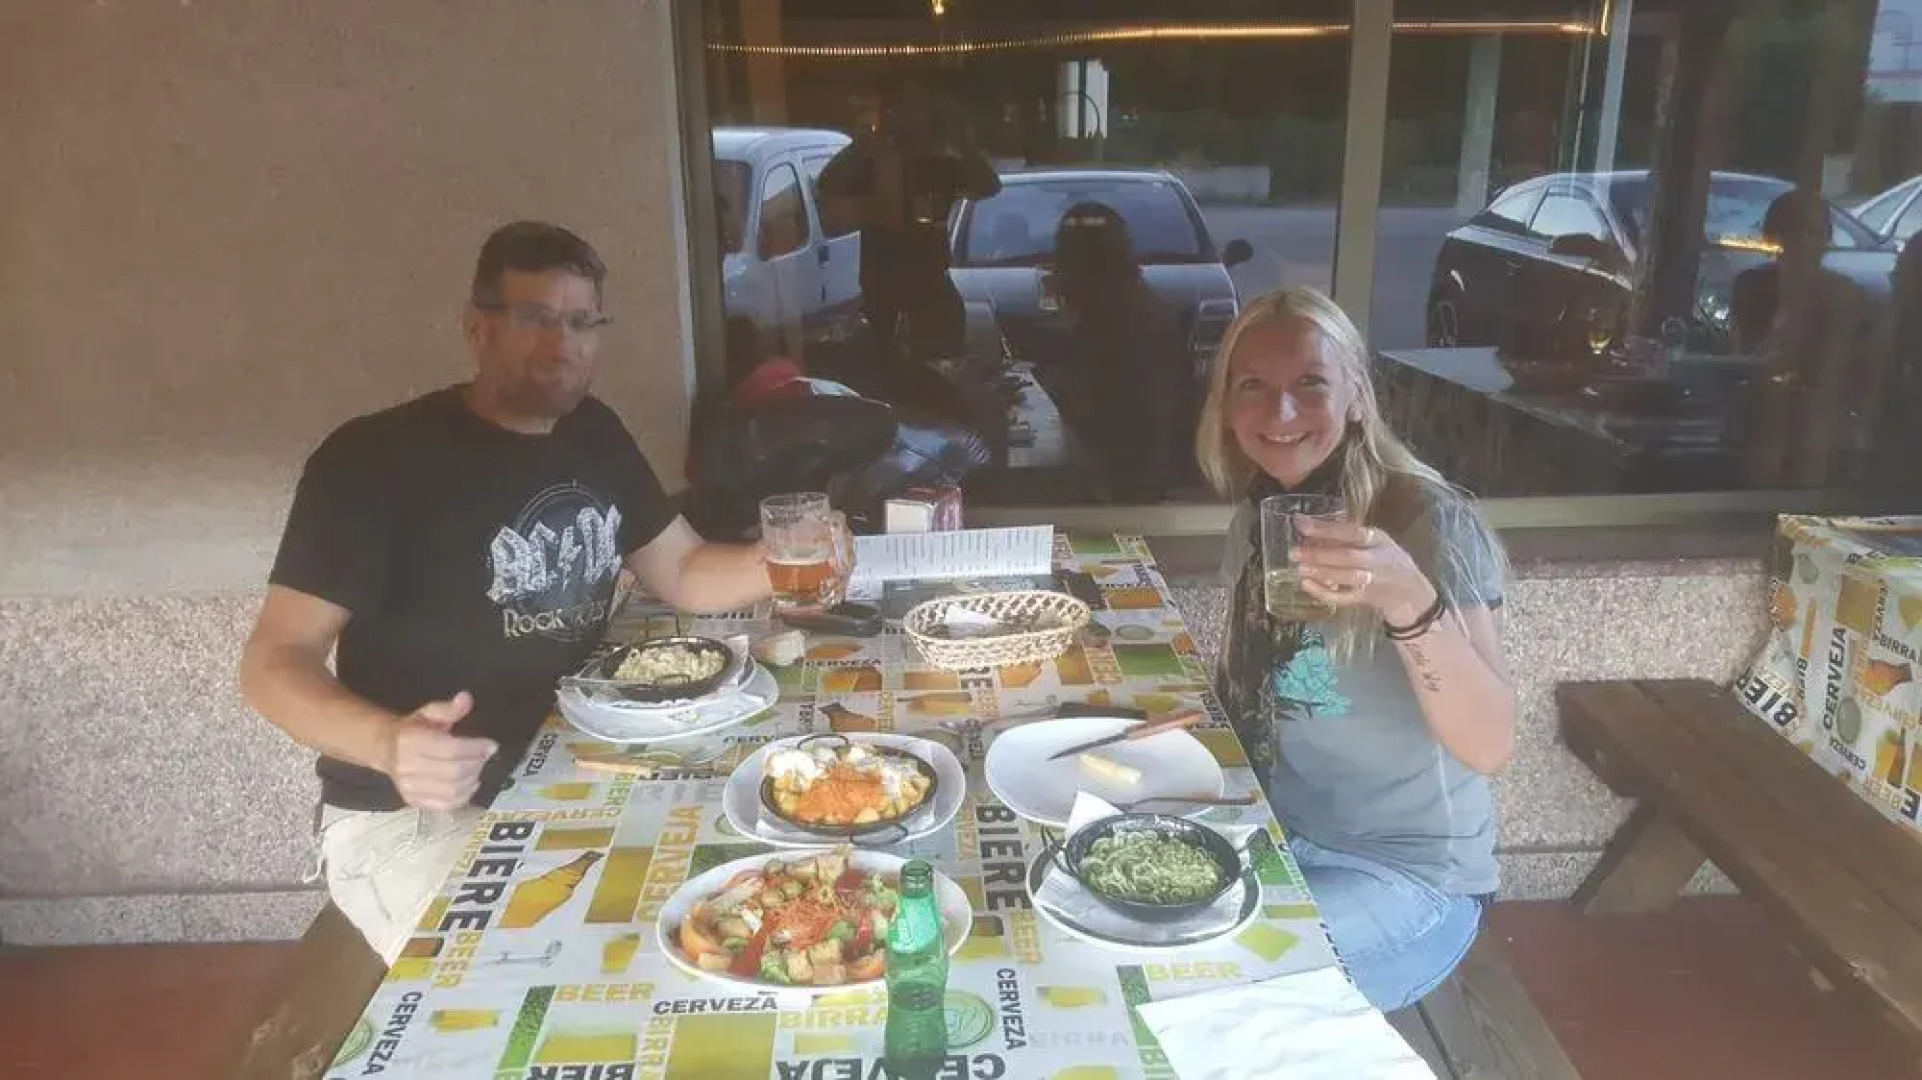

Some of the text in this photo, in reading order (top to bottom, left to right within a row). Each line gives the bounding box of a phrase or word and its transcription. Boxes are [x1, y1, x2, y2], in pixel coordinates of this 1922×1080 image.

[1823, 628, 1846, 730] CERVEJA
[361, 990, 423, 1076] CERVEZA
[555, 983, 655, 1001] BEER
[653, 997, 779, 1015] CERVEZA
[996, 968, 1028, 1050] CERVEZA
